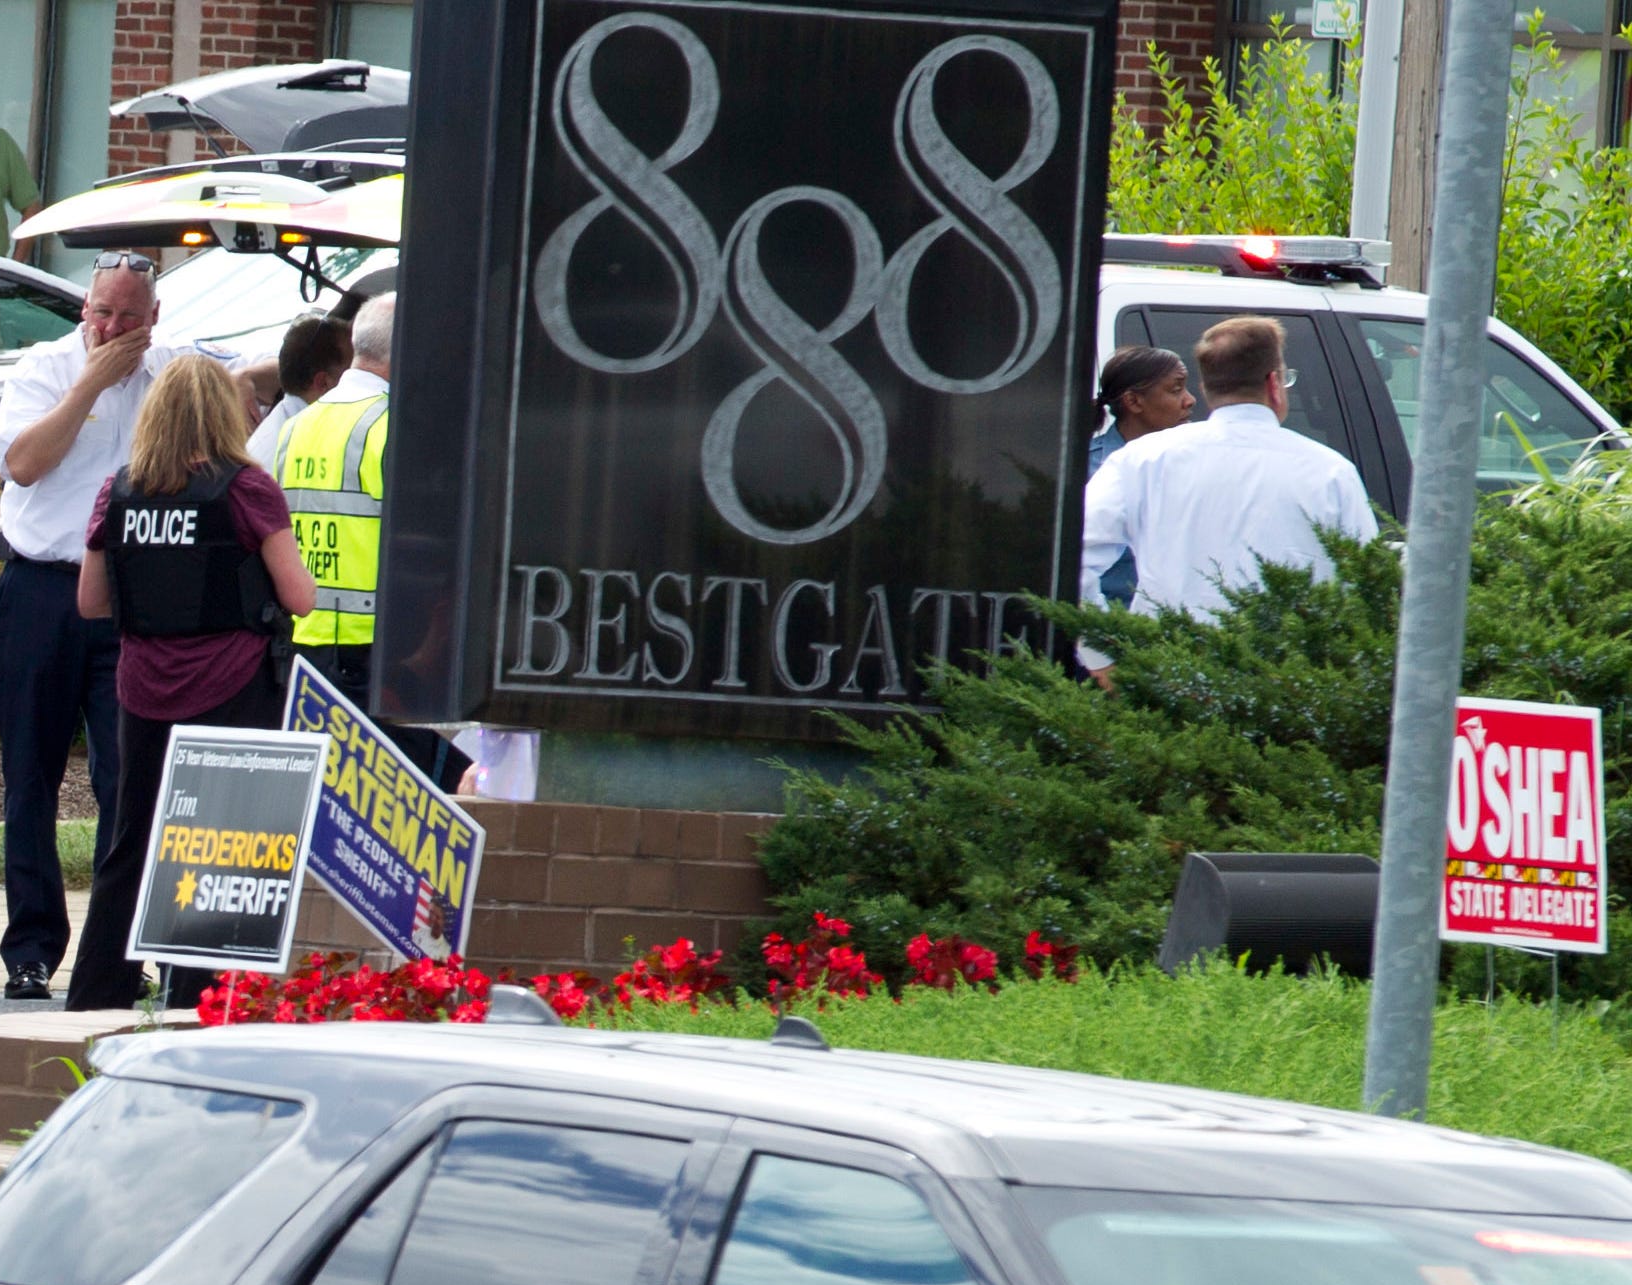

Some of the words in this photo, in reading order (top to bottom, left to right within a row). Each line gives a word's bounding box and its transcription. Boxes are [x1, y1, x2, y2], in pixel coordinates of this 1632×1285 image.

[123, 509, 198, 544] POLICE
[307, 550, 340, 581] DEPT
[328, 705, 472, 849] SHERIFF
[1447, 716, 1597, 865] O'SHEA
[165, 788, 198, 819] Jim
[322, 735, 467, 909] BATEMAN
[158, 825, 297, 872] FREDERICKS
[354, 825, 415, 896] PEOPLE'S
[194, 874, 290, 916] SHERIFF
[1449, 880, 1505, 920] STATE
[1509, 887, 1597, 928] DELEGATE
